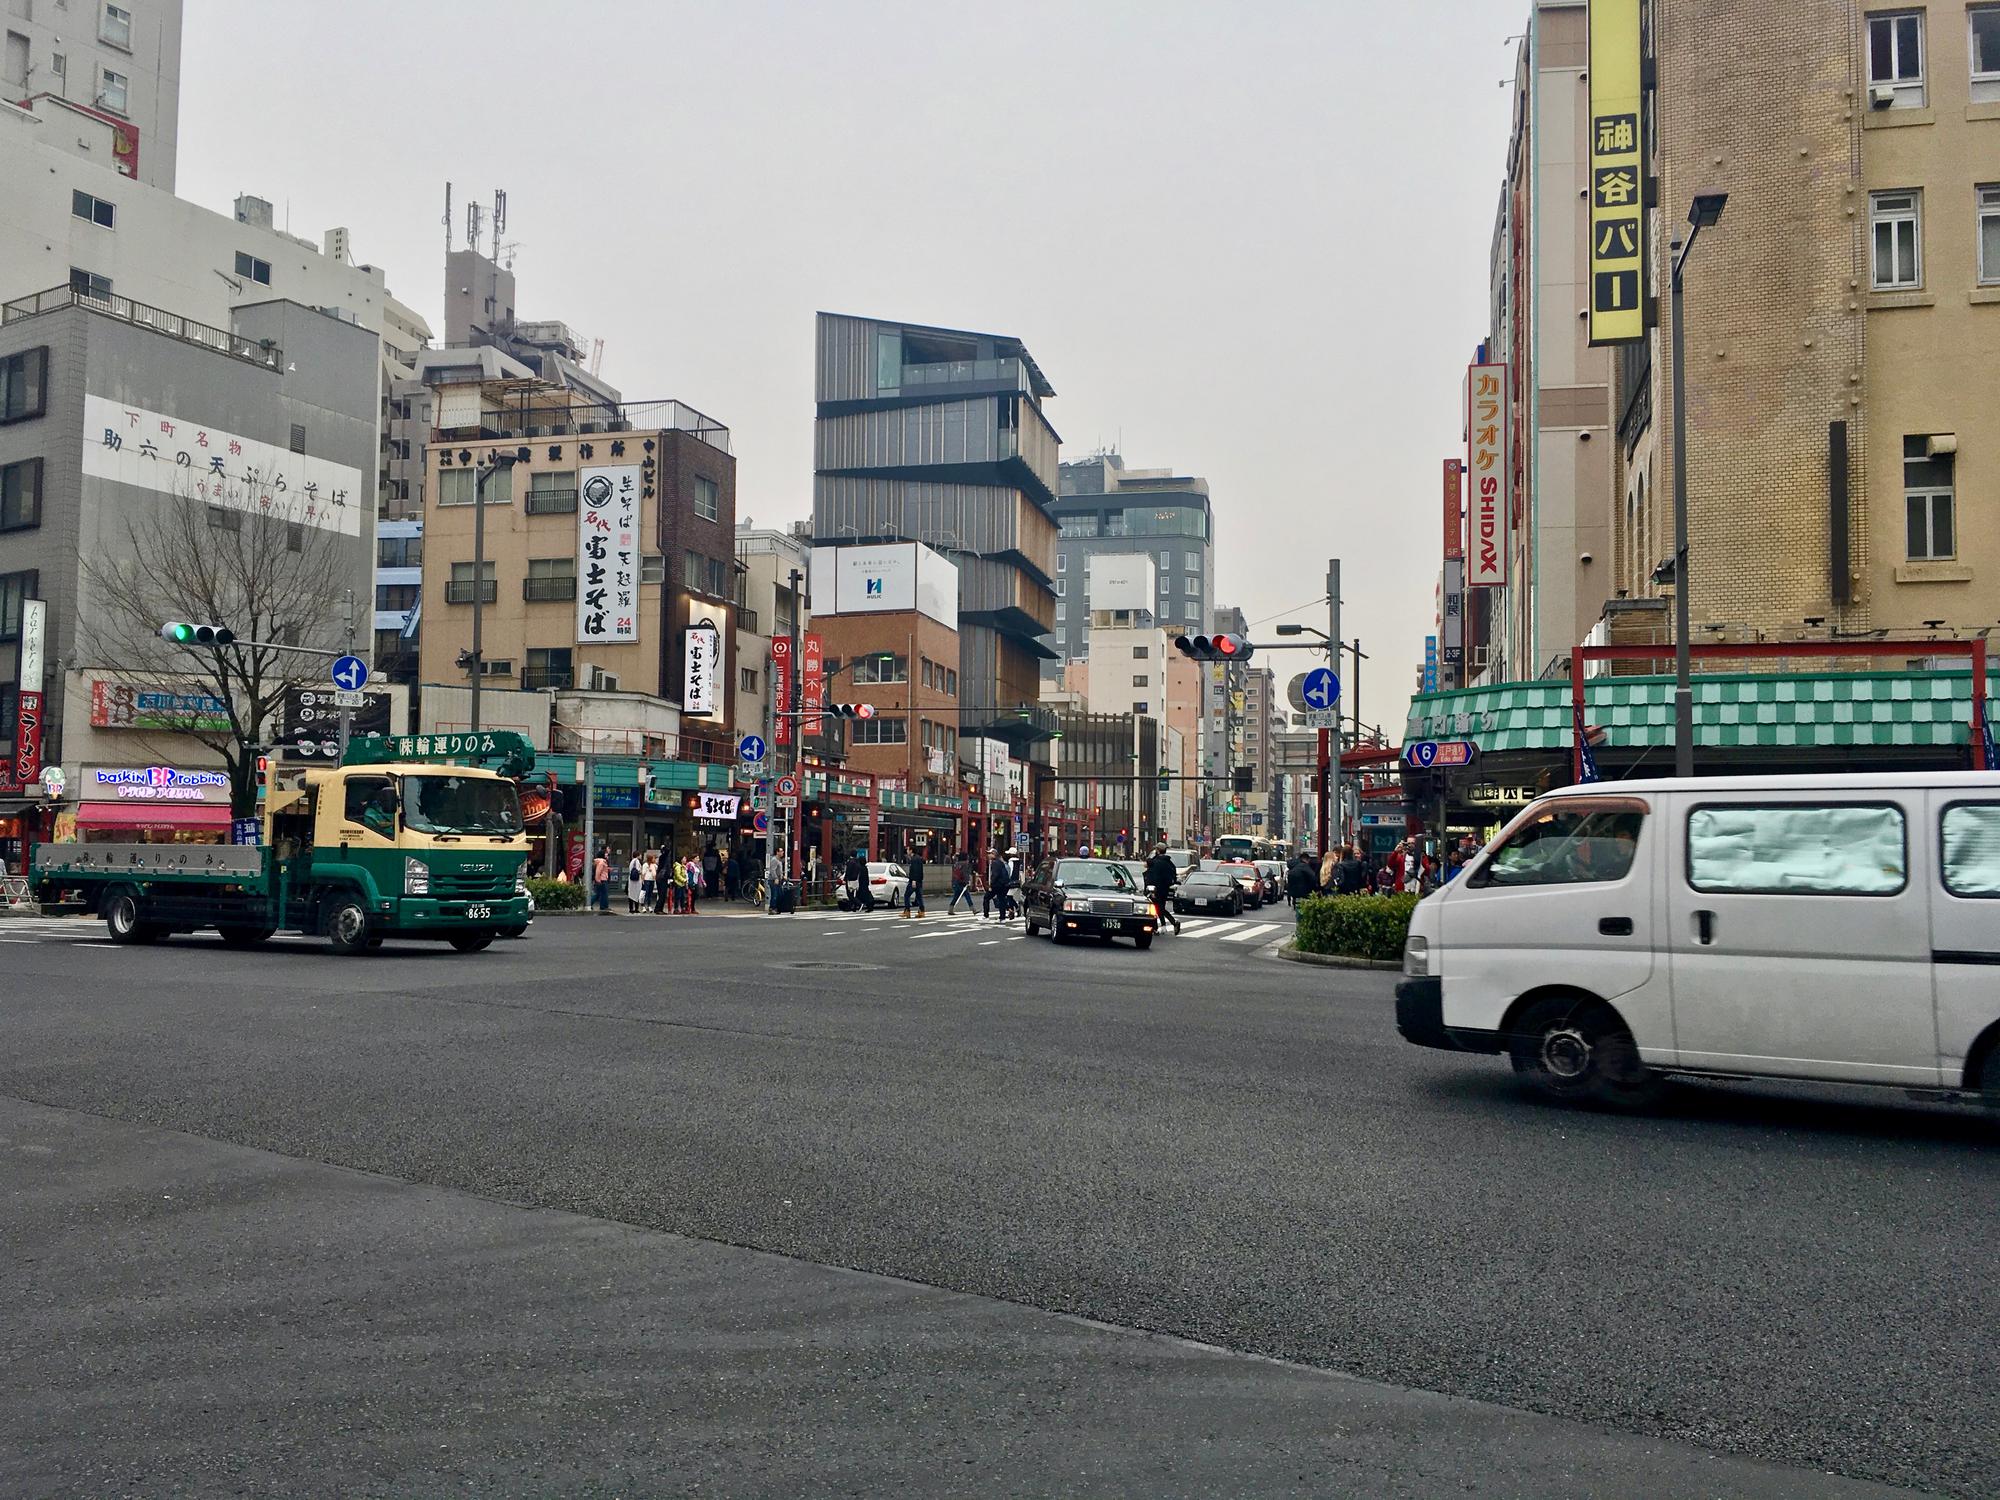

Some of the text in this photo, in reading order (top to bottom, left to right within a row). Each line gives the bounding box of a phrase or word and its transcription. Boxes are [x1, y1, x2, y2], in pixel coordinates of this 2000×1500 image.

[1597, 119, 1637, 308] 神谷バー
[125, 411, 242, 456] 下町名物
[1476, 373, 1500, 471] カラオケ
[102, 428, 349, 508] 助六の天ぷらそば
[643, 439, 656, 499] 中山ビル
[584, 511, 611, 532] 名代
[619, 475, 634, 529] 生そば
[1480, 477, 1497, 574] SHIDAX
[585, 535, 610, 635] 富士そば
[617, 618, 631, 626] 24
[617, 627, 631, 635] 時間
[689, 646, 704, 700] 富士そば
[18, 712, 37, 779] ラーメン
[1422, 746, 1431, 760] 6
[96, 767, 227, 787] baskin BR robbins
